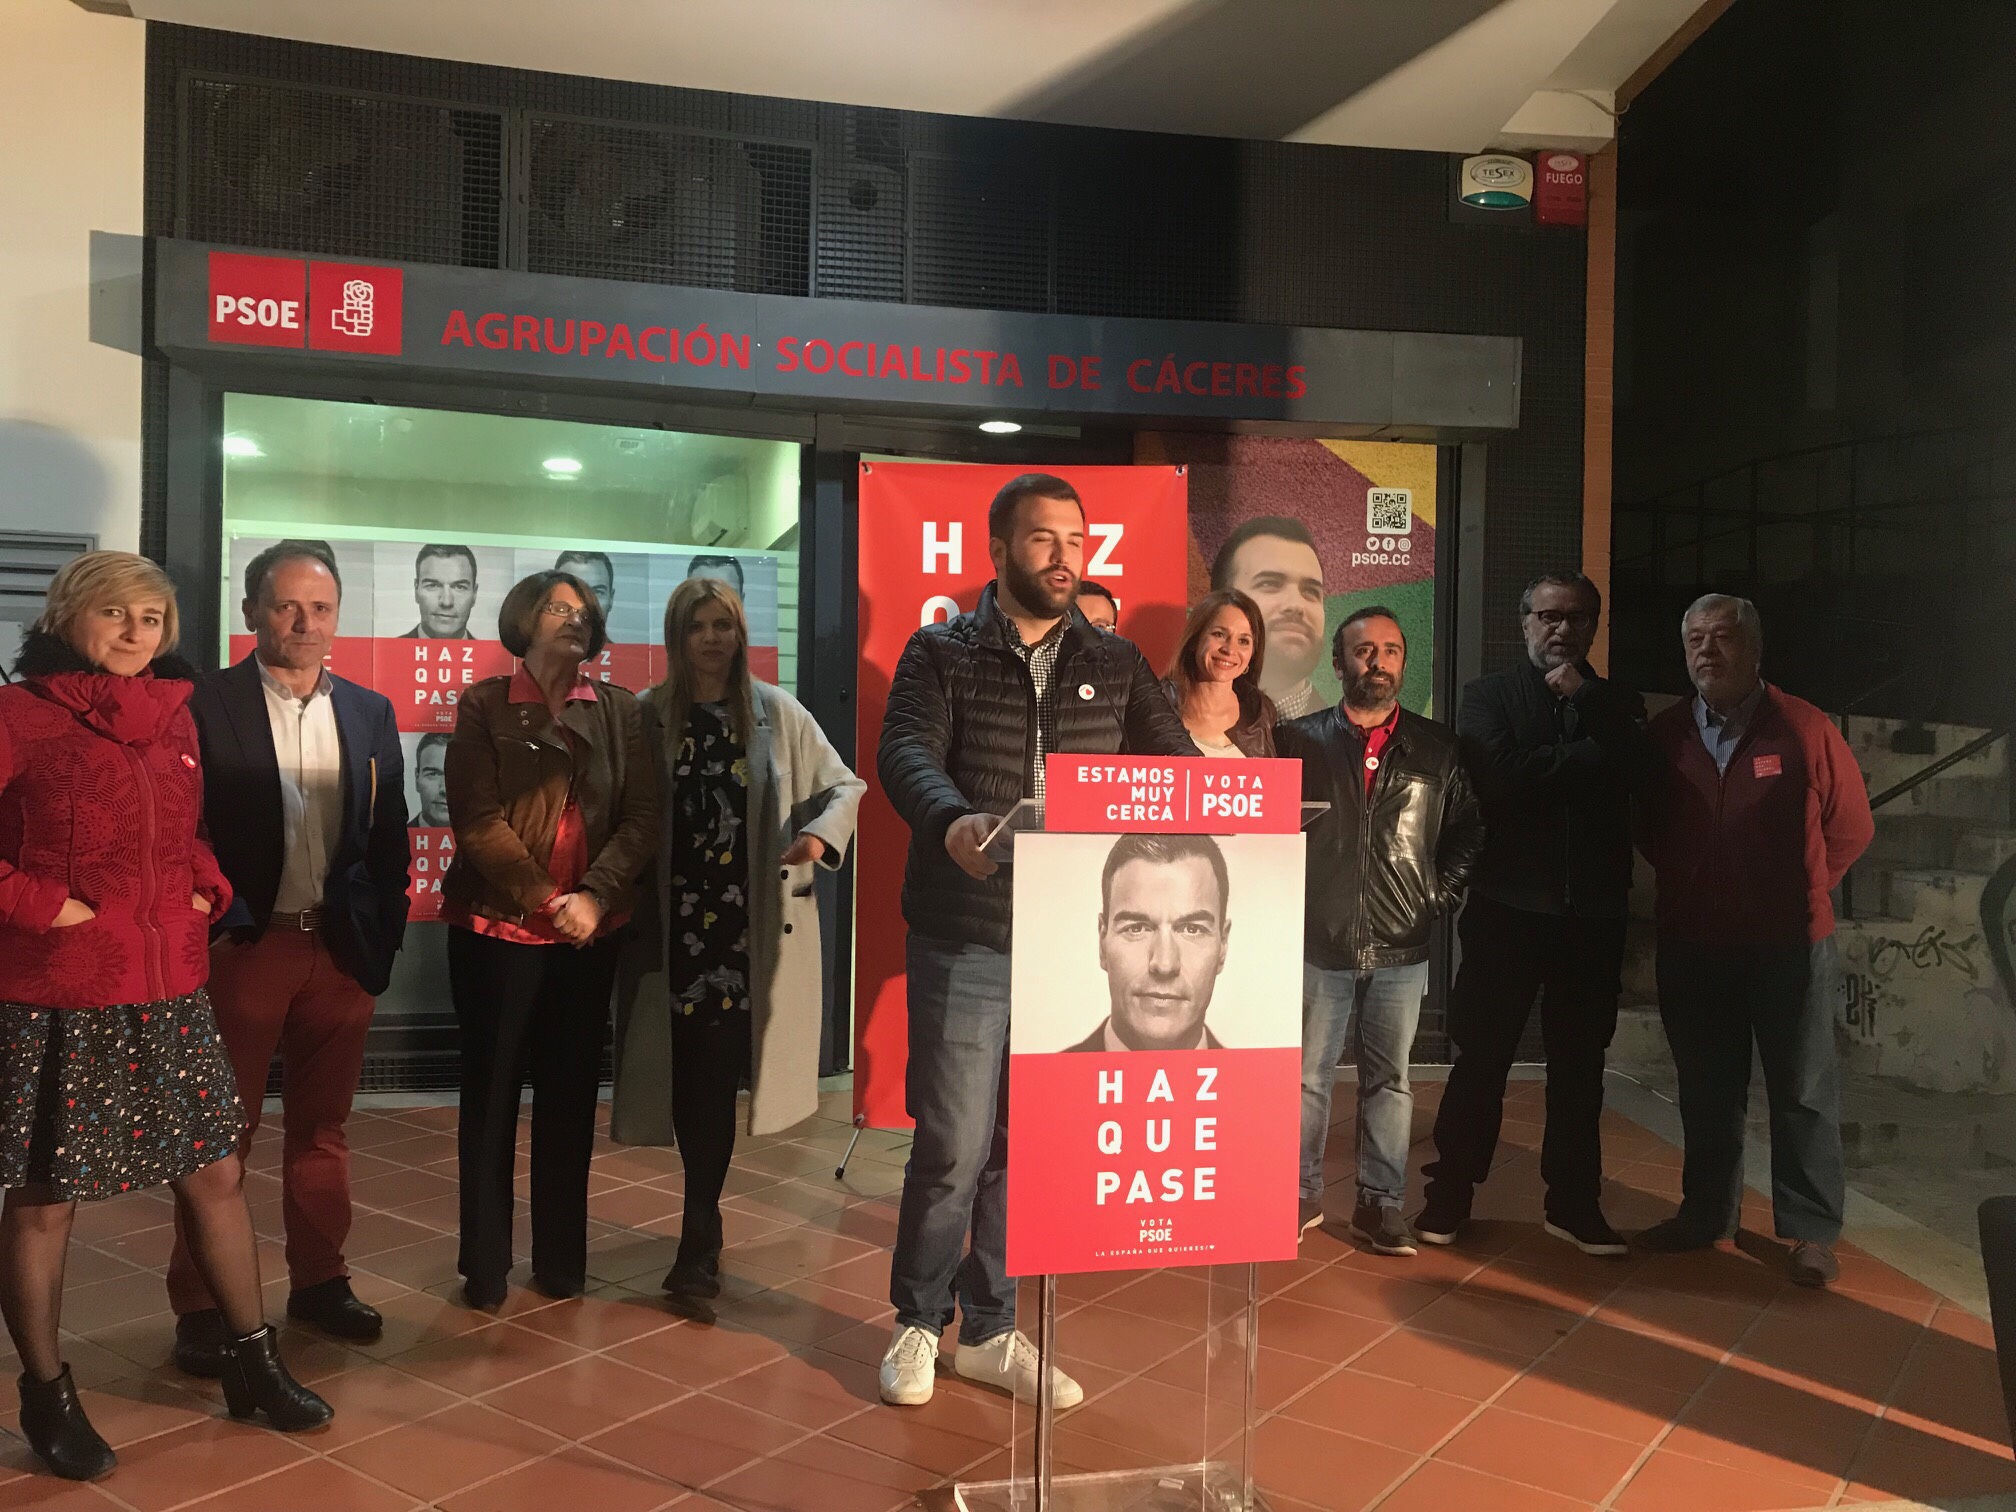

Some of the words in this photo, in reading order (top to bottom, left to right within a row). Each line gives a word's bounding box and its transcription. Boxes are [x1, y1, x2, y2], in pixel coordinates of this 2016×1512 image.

[1545, 172, 1583, 185] FUEGO
[216, 294, 299, 329] PSOE
[440, 309, 751, 370] AGRUPACIÓN
[775, 335, 1025, 390] SOCIALISTA
[1047, 354, 1102, 390] DE
[1126, 352, 1308, 400] CÁCERES
[922, 521, 1124, 576] HZ
[1351, 552, 1411, 567] psoe.cc
[415, 646, 474, 662] HAZ
[414, 667, 474, 684] QUE
[414, 689, 460, 706] PAS
[1077, 766, 1175, 784] ESTAMOS
[1203, 775, 1264, 789] VOTA
[1130, 786, 1175, 803] MUY
[1105, 804, 1174, 822] CERCA
[1202, 793, 1264, 818] PSOE
[416, 834, 453, 850] HA
[416, 856, 452, 872] QU
[1098, 1067, 1218, 1104] HAZ
[1097, 1117, 1217, 1155] QUE
[1096, 1166, 1217, 1206] PASE
[1140, 1218, 1173, 1227] VOTA
[1139, 1228, 1173, 1243] PSOE
